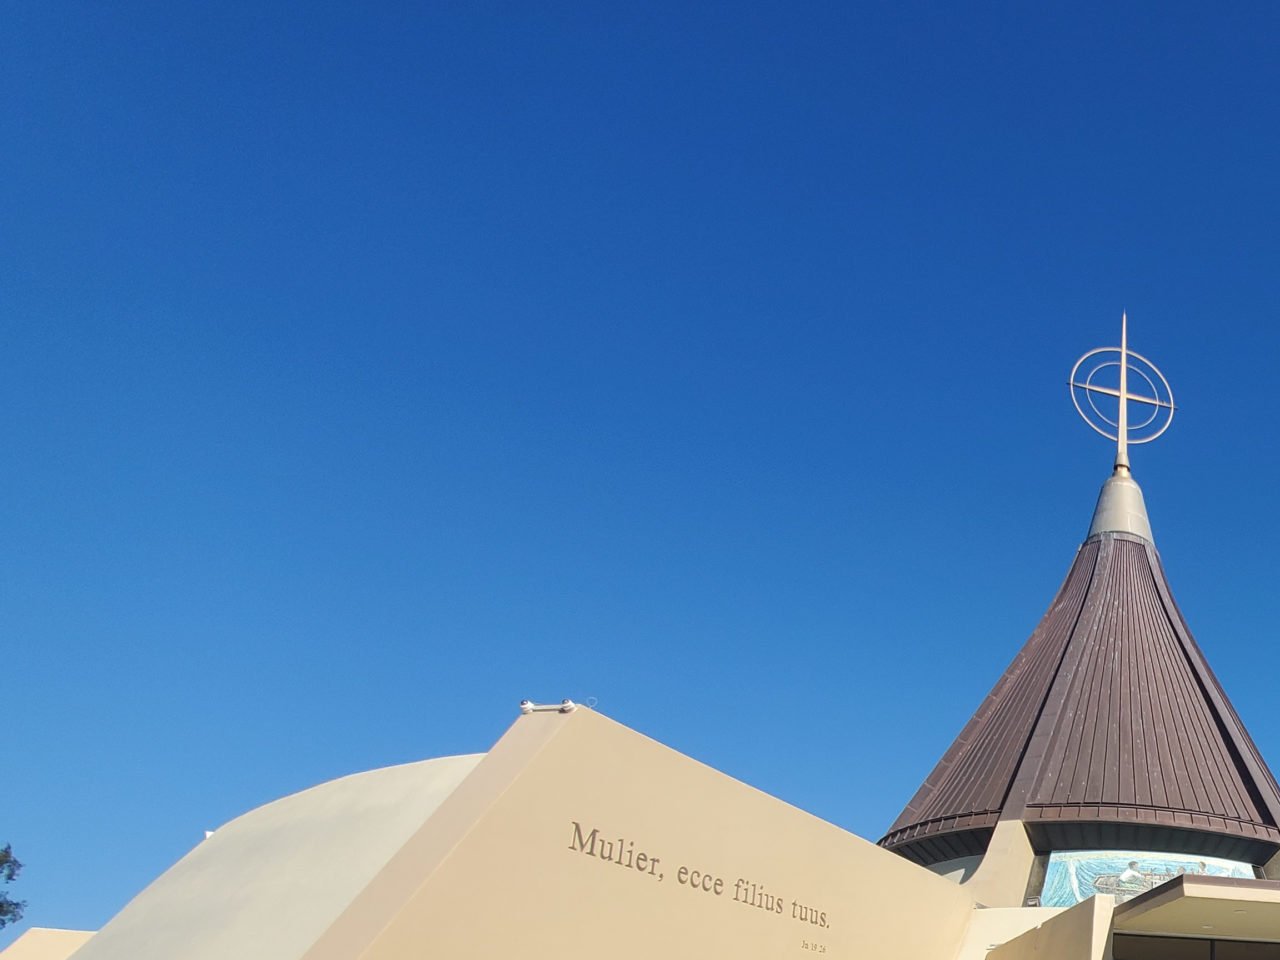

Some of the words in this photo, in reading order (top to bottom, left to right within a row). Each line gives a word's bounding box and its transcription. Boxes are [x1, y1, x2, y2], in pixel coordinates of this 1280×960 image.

[568, 821, 665, 882] Mulier,
[677, 864, 724, 896] ecce
[732, 878, 784, 915] filius
[791, 899, 831, 929] tuus.
